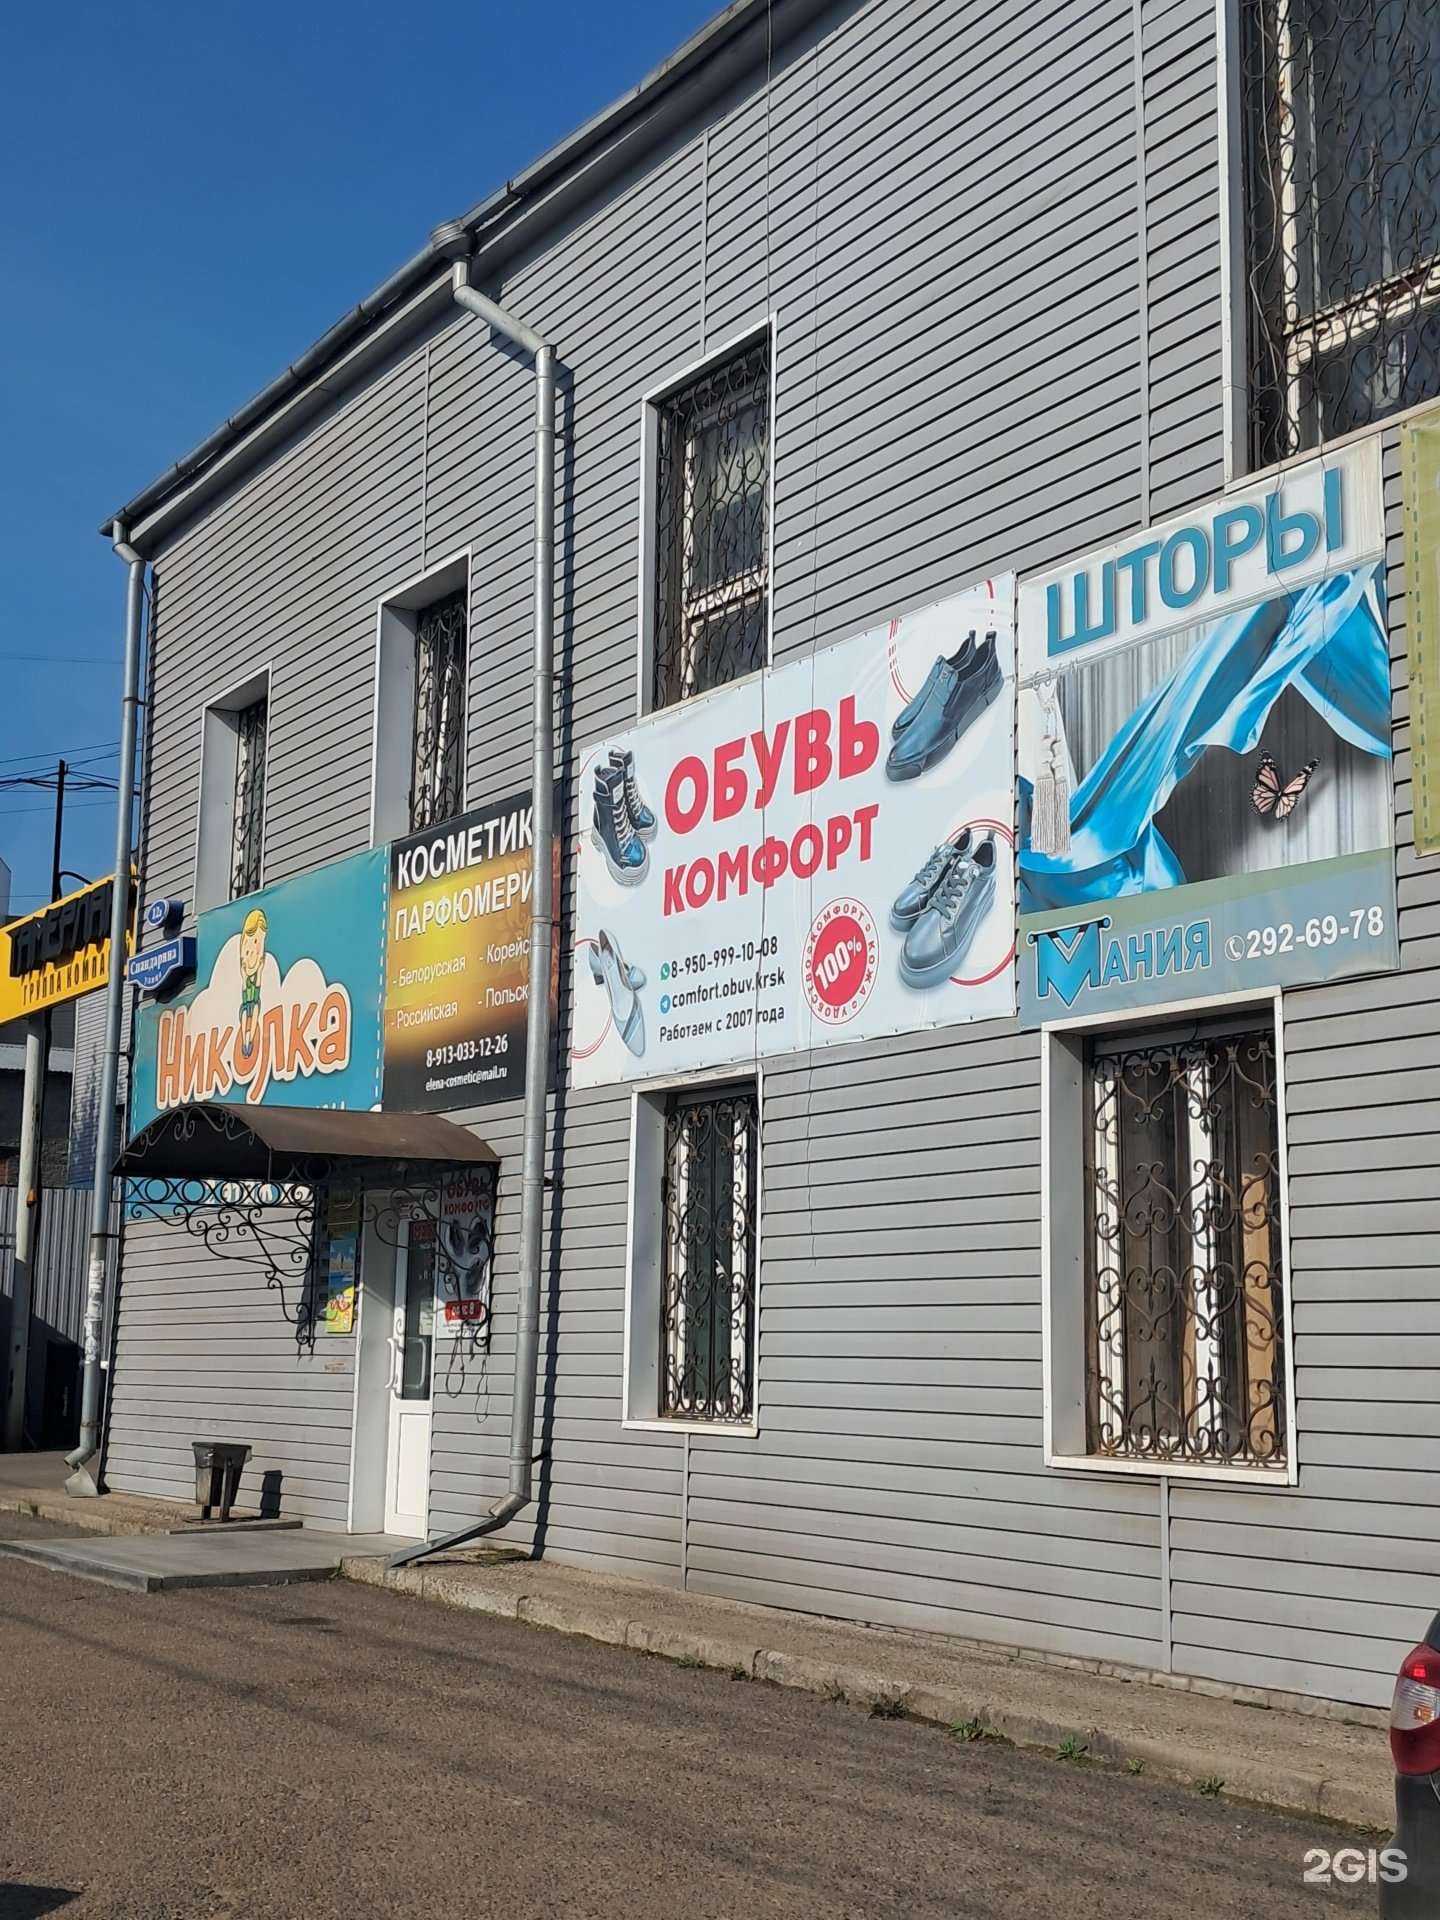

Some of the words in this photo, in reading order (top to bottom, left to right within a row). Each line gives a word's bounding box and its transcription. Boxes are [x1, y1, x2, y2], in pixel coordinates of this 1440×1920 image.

[1046, 467, 1344, 657] ШТОРЫ
[664, 695, 880, 835] ОБУВЬ
[397, 806, 533, 890] КОСМЕТИК
[662, 803, 880, 917] КОМФОРТ
[8, 879, 113, 978] ТАМЕРЛА
[394, 869, 533, 943] ПАРФЮМЕРИ
[810, 903, 865, 943] КОМФОРТ
[1246, 906, 1384, 959] 292-69-78
[398, 955, 467, 987] Белорусская
[486, 935, 532, 968] Корейс
[671, 935, 778, 979] 8-950-999-10-08
[814, 935, 863, 991] 100%
[859, 940, 876, 997] КОЖА
[23, 975, 62, 1006] ГРУППА
[66, 952, 106, 989] КОМПА
[485, 984, 530, 1009] Польск
[672, 966, 785, 1009] comfort.obuv.krsk
[804, 959, 849, 1019] УДОБСТВО
[397, 1001, 459, 1029] Российская
[659, 1021, 713, 1043] Работаем
[716, 1019, 722, 1032] с
[725, 1008, 753, 1030] 2007
[756, 1006, 785, 1025] года
[426, 1033, 508, 1068] 8-913-033-12-26
[425, 1065, 508, 1092] elena-cosmetic@mail.ru
